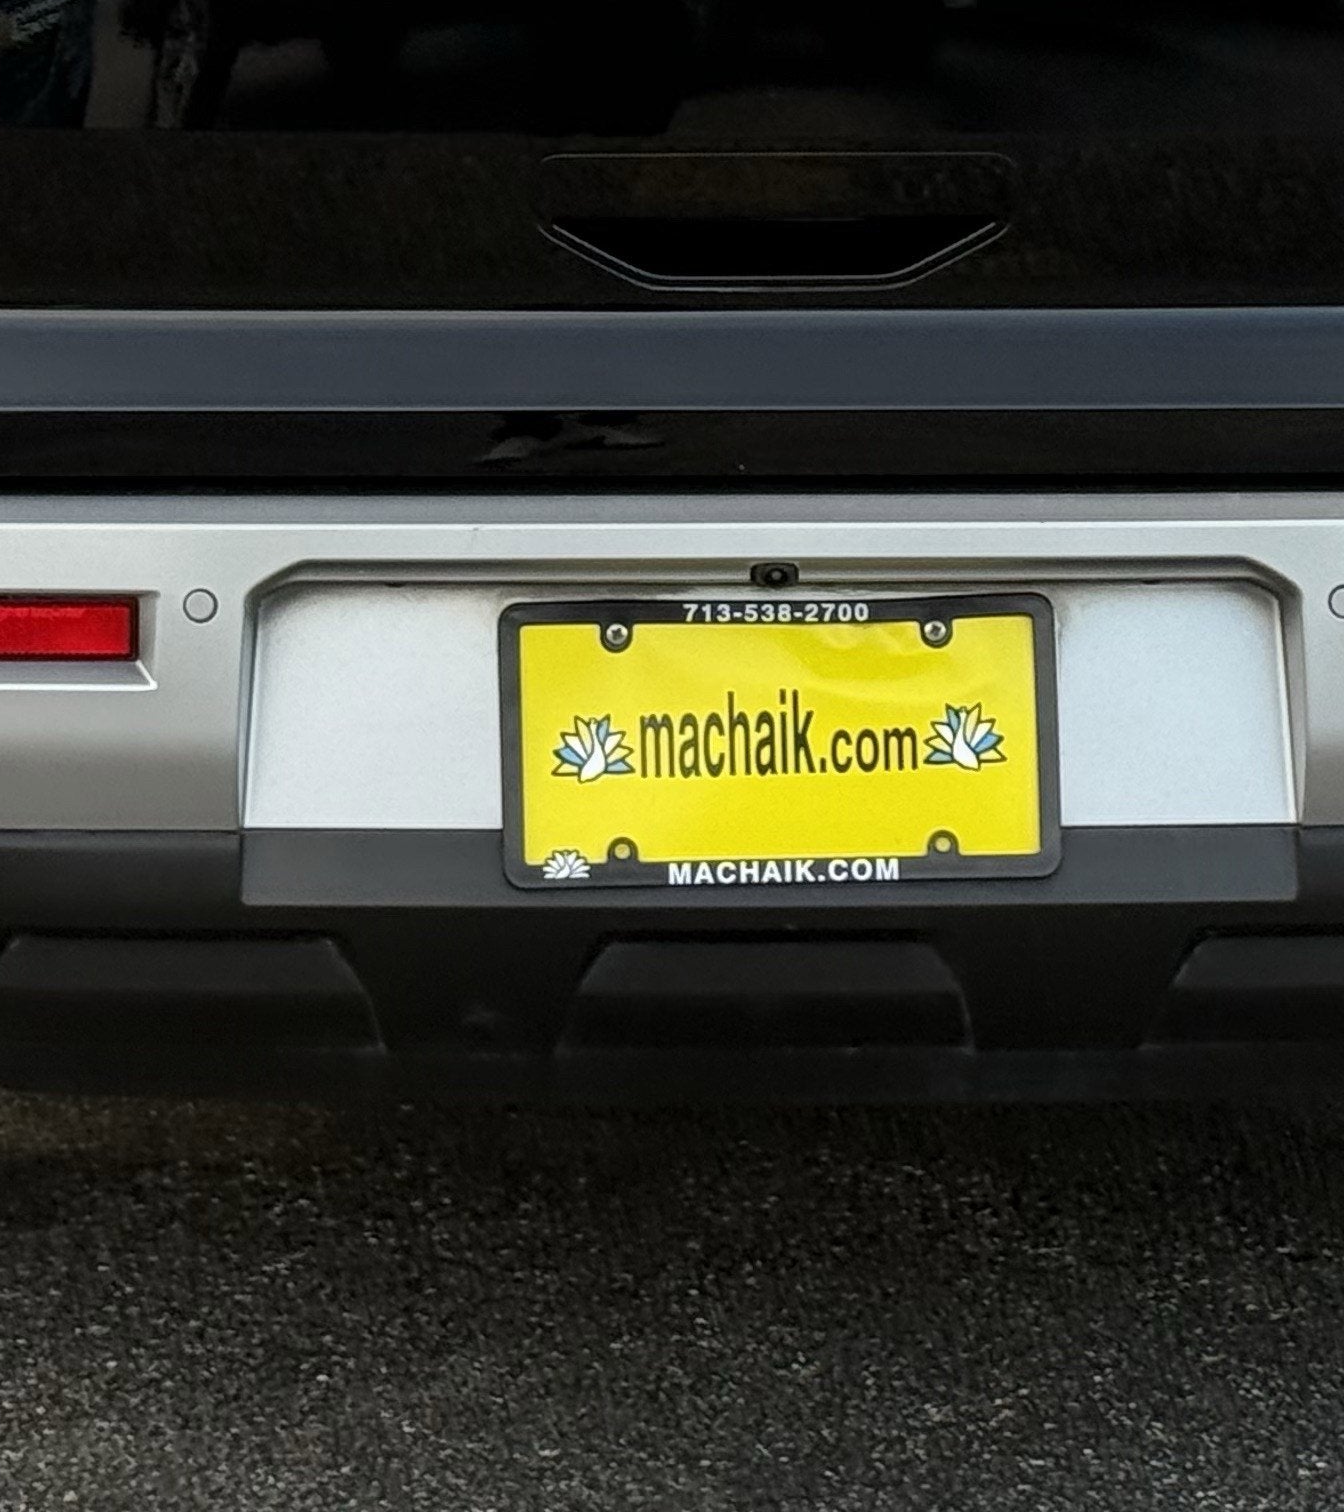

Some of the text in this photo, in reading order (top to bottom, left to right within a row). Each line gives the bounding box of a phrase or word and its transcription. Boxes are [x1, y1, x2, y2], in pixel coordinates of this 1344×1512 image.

[682, 603, 870, 623] 713-538-2700
[639, 689, 919, 779] machaik.com
[668, 858, 901, 885] MACHAIK.COM
